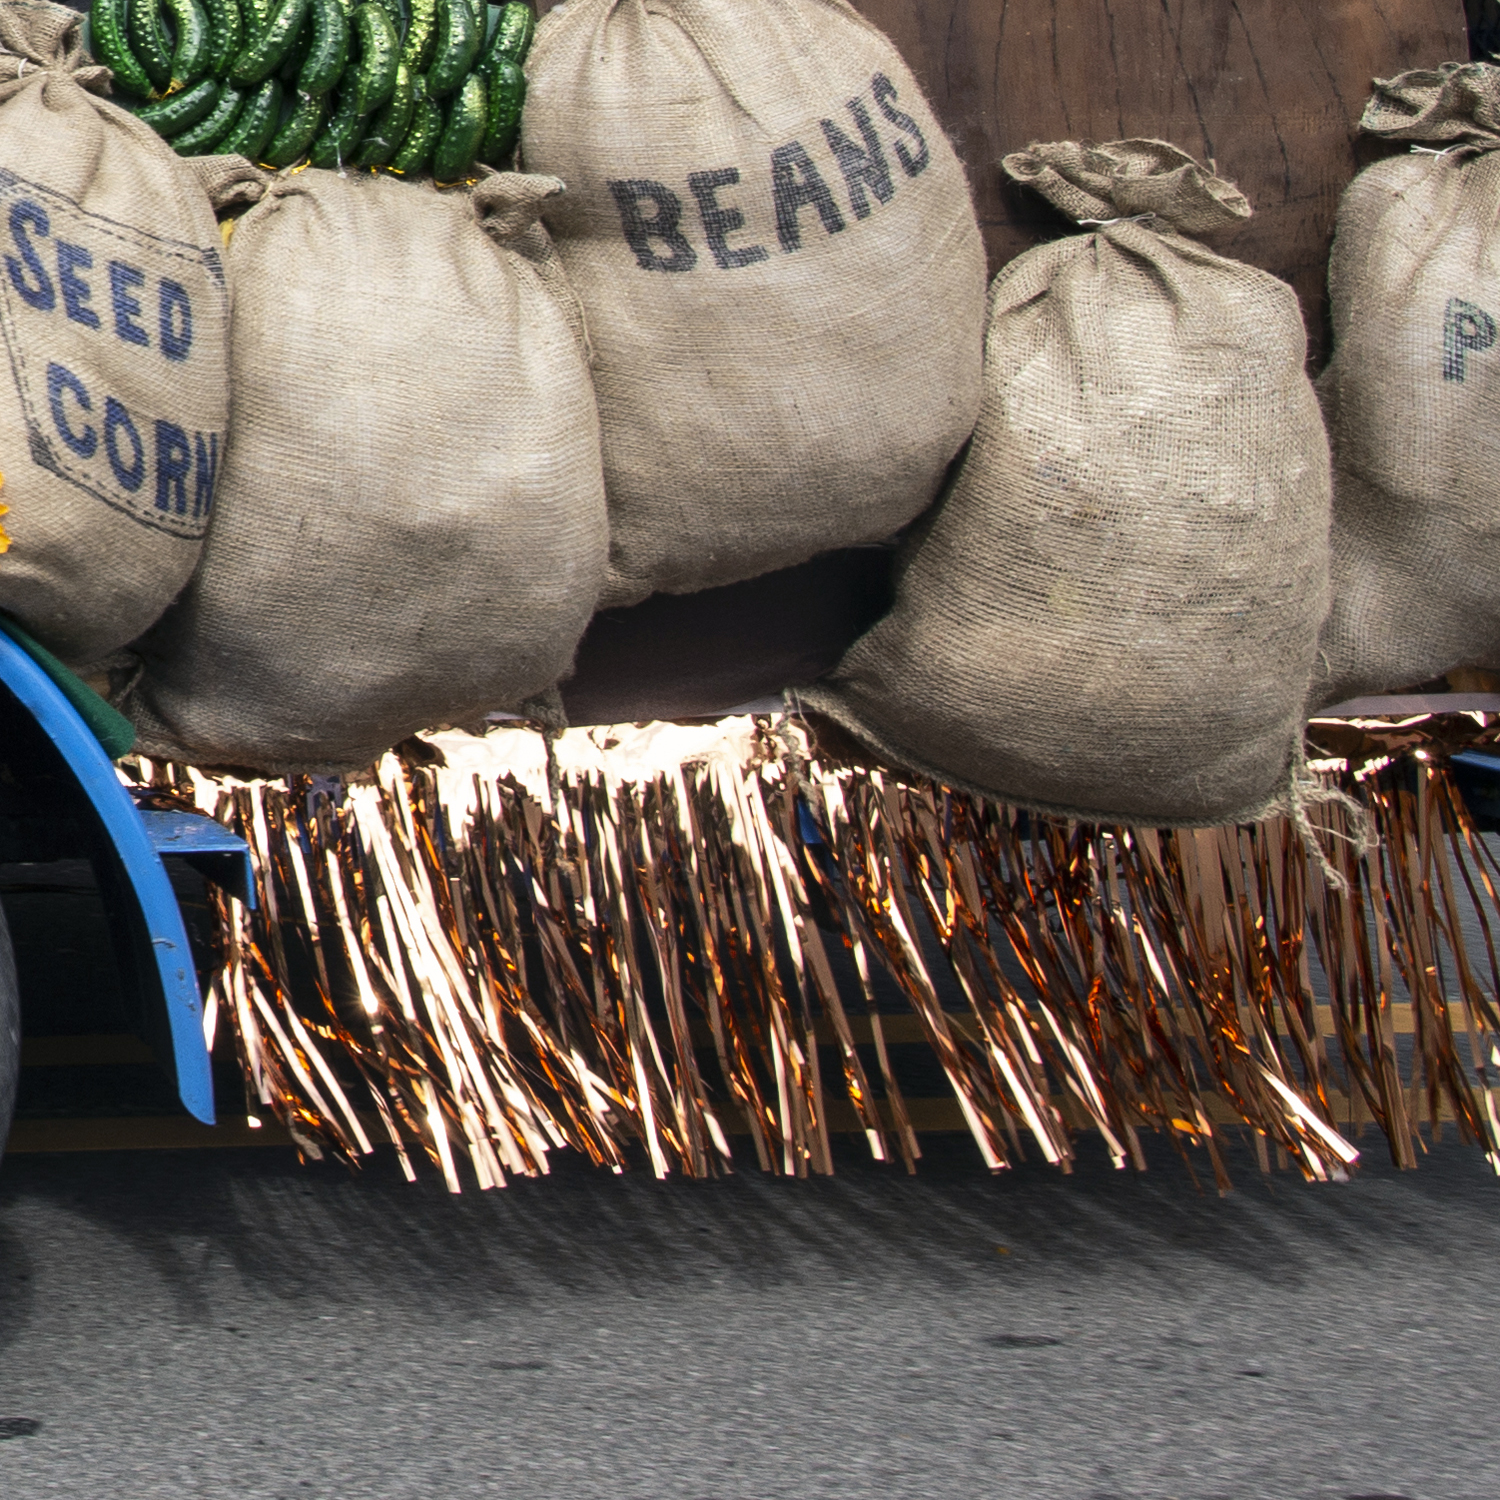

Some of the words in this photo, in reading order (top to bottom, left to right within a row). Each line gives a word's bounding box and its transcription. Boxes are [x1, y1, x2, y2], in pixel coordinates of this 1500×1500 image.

[607, 71, 931, 273] BEANS
[3, 200, 194, 363] SEED
[47, 361, 218, 519] CORN
